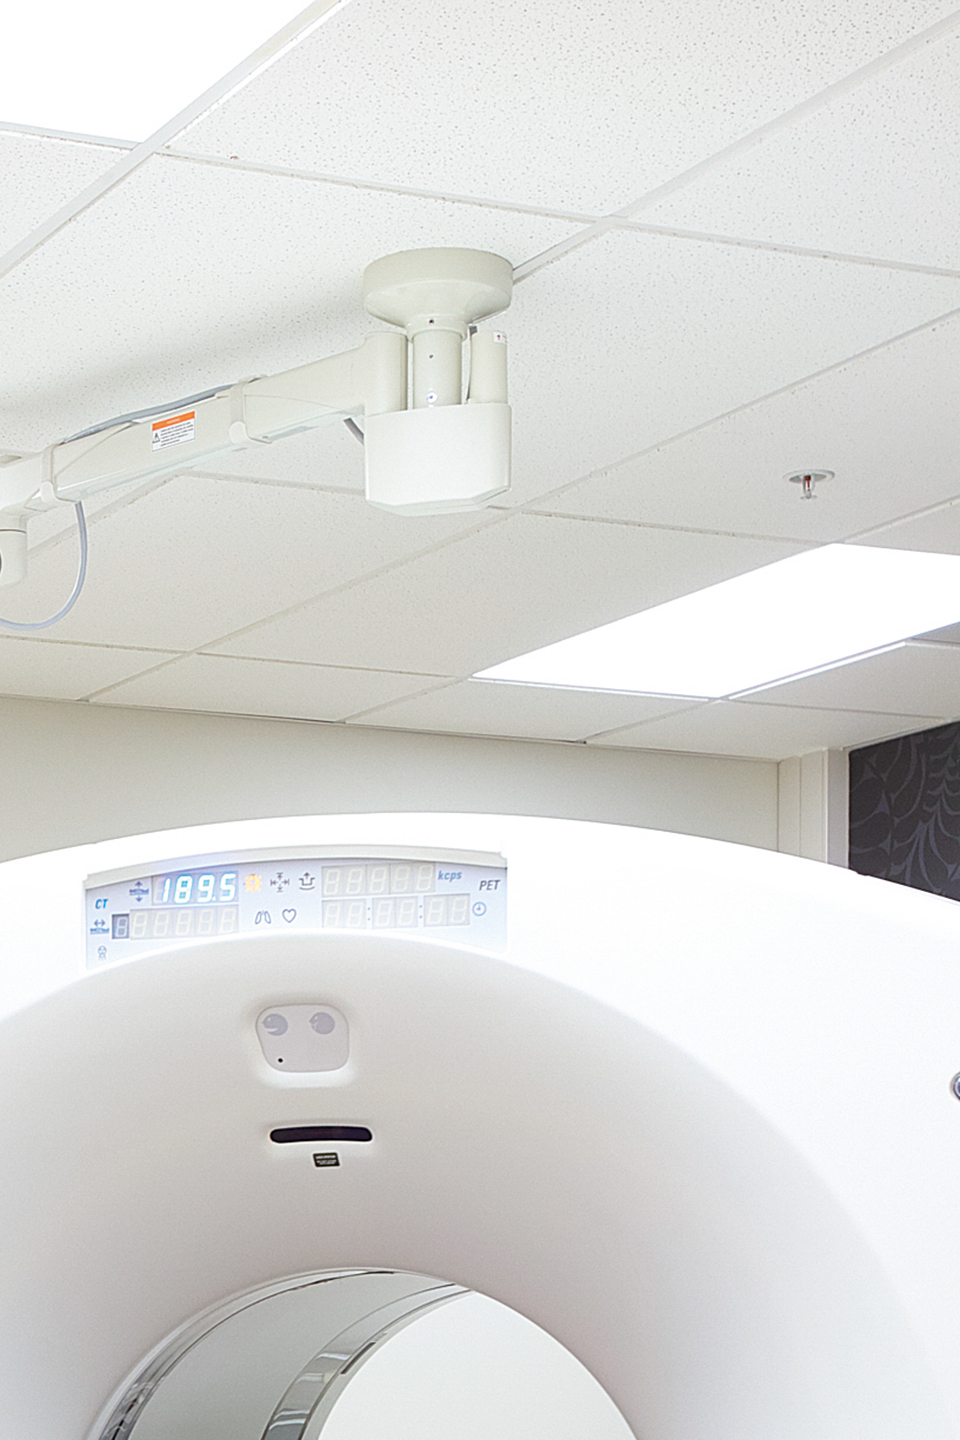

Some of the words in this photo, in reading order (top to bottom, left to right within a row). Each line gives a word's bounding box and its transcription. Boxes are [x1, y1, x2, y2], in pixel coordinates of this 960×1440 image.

[438, 871, 462, 882] kcps
[161, 872, 237, 904] 189.5
[479, 880, 500, 890] PET
[95, 898, 109, 909] CT
